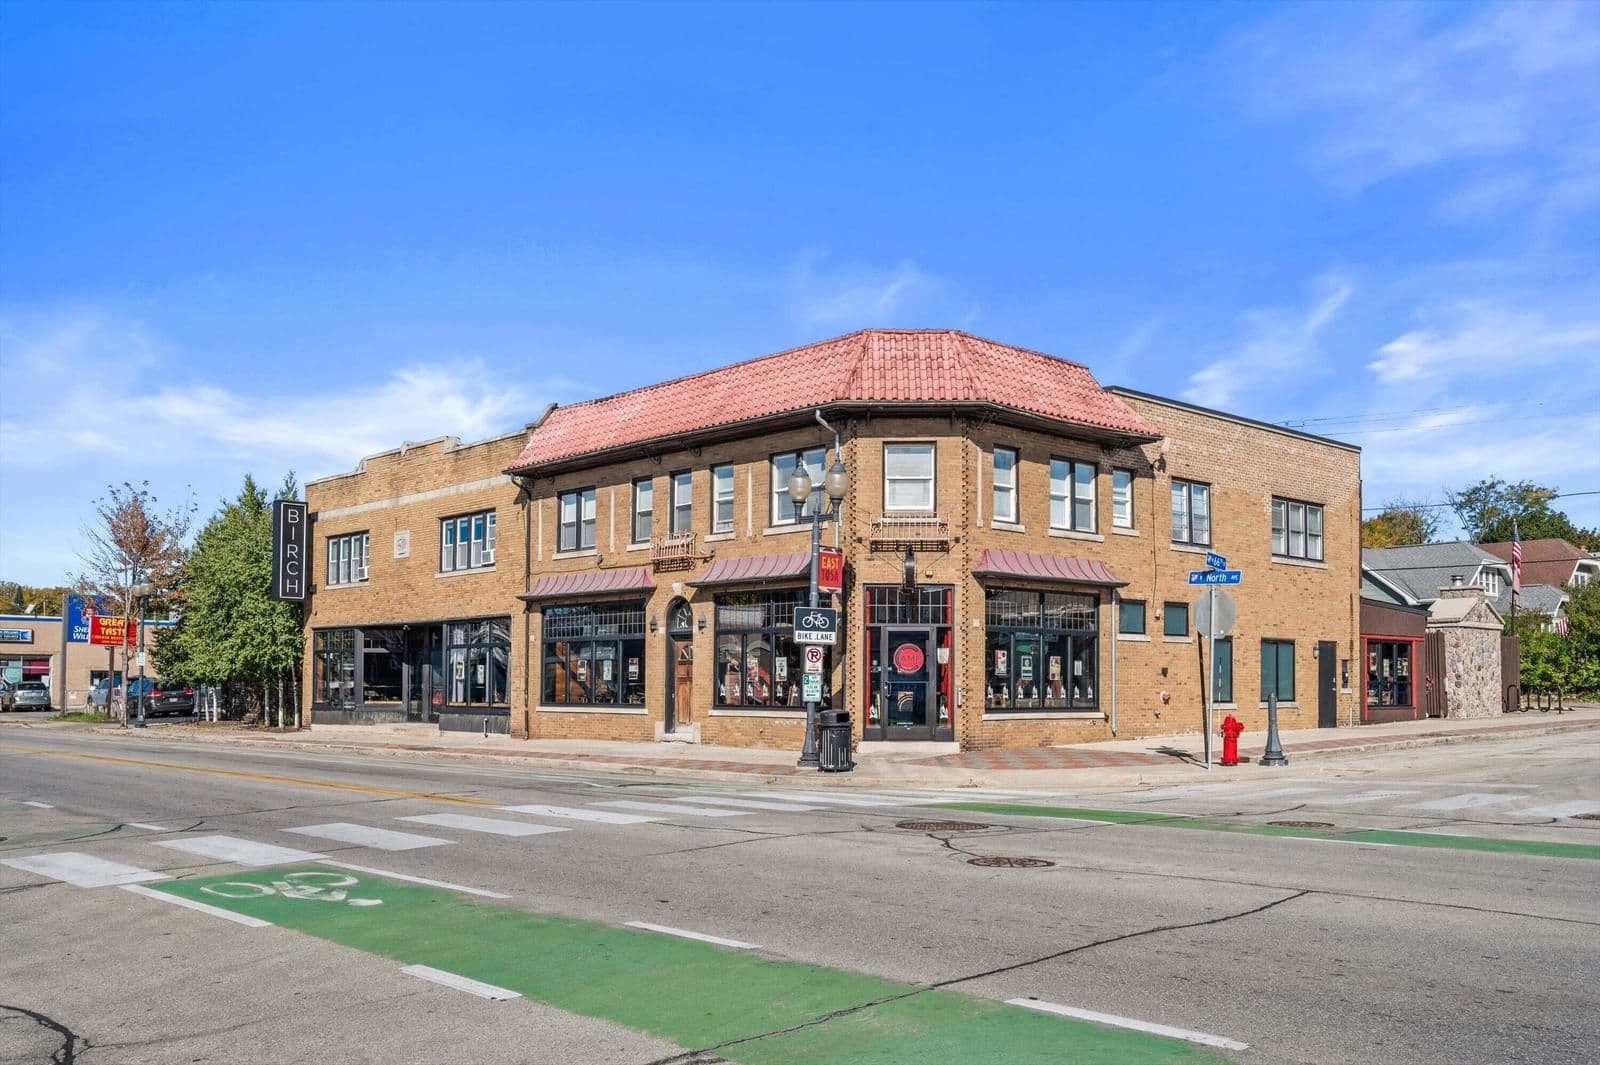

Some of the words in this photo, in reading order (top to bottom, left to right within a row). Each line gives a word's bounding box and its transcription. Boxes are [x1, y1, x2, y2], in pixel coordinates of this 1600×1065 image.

[286, 508, 299, 593] BIRCH
[822, 556, 839, 569] EAST
[822, 569, 839, 582] TOSA
[1206, 573, 1227, 582] North
[99, 618, 126, 627] GREA
[73, 625, 89, 633] SHE
[797, 632, 813, 640] BIKE
[816, 633, 833, 641] LANE
